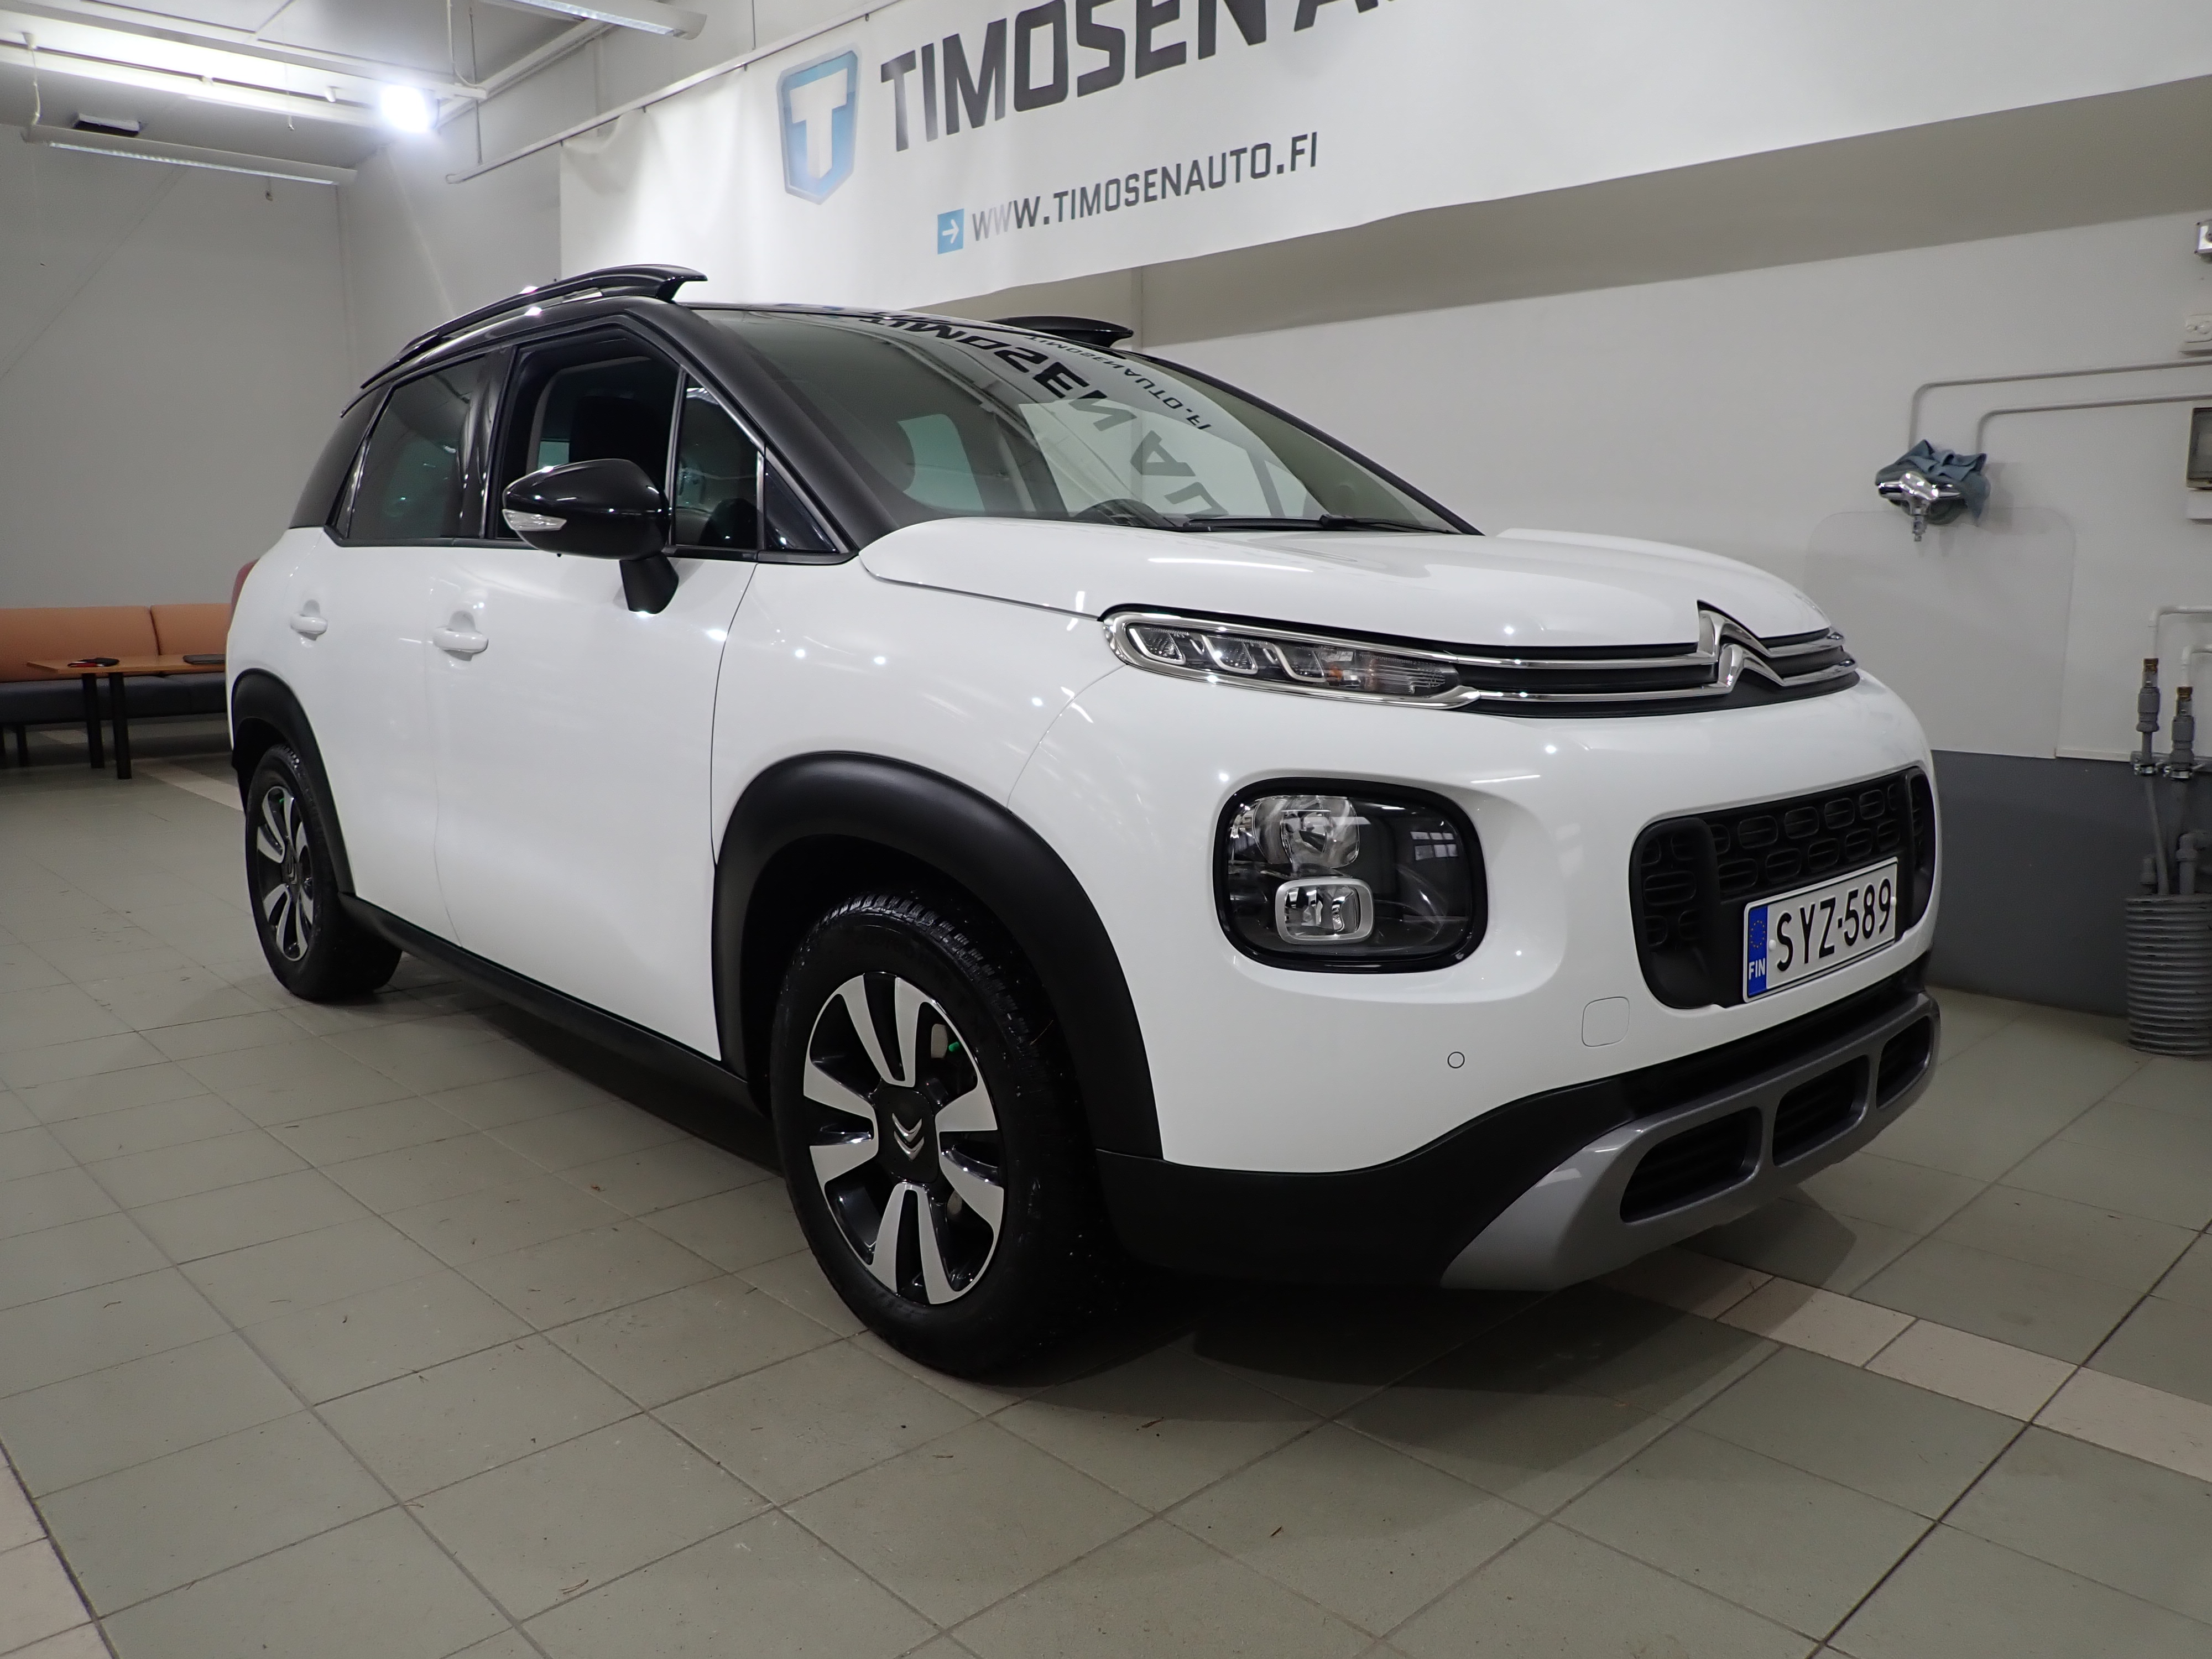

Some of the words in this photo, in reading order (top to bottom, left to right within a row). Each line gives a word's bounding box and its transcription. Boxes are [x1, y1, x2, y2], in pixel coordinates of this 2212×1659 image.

[972, 131, 1317, 242] WWW.TIMOSENAUTO.FI
[1748, 958, 1766, 980] FIN
[1776, 878, 1892, 972] SYZ-589
